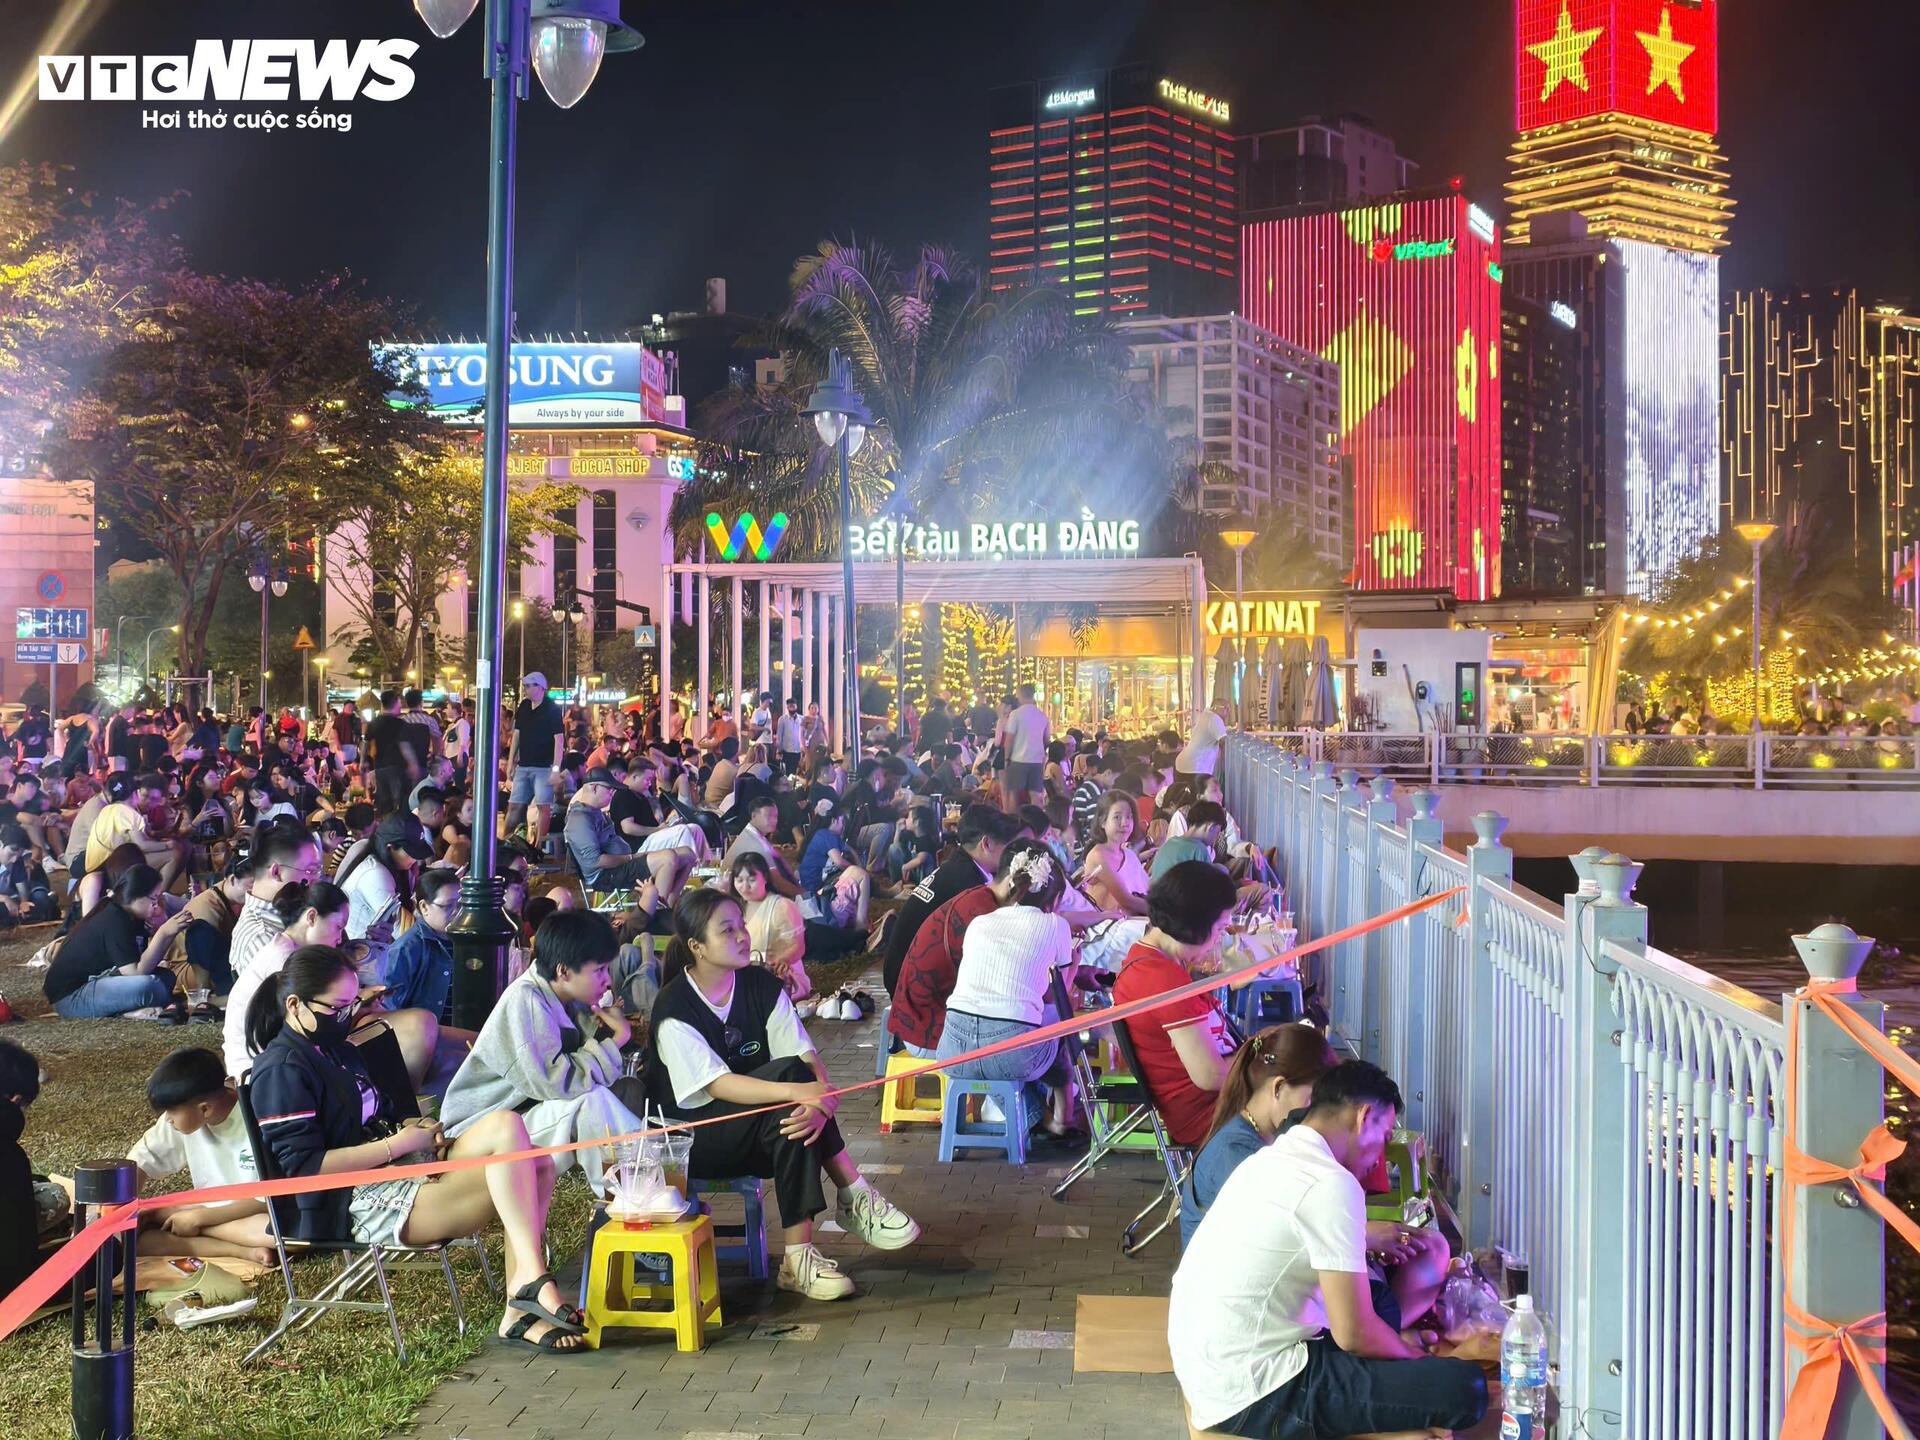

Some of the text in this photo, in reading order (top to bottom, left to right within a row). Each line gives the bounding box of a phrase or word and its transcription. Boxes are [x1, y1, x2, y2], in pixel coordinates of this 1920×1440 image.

[1160, 78, 1187, 104] THE
[537, 407, 625, 419] Always by your side
[571, 458, 650, 475] COCOA SHOP
[914, 521, 961, 556] tàu
[970, 521, 1048, 562] BẠCH
[1058, 505, 1140, 552] ĐẰNG
[1206, 600, 1321, 636] KATINAT
